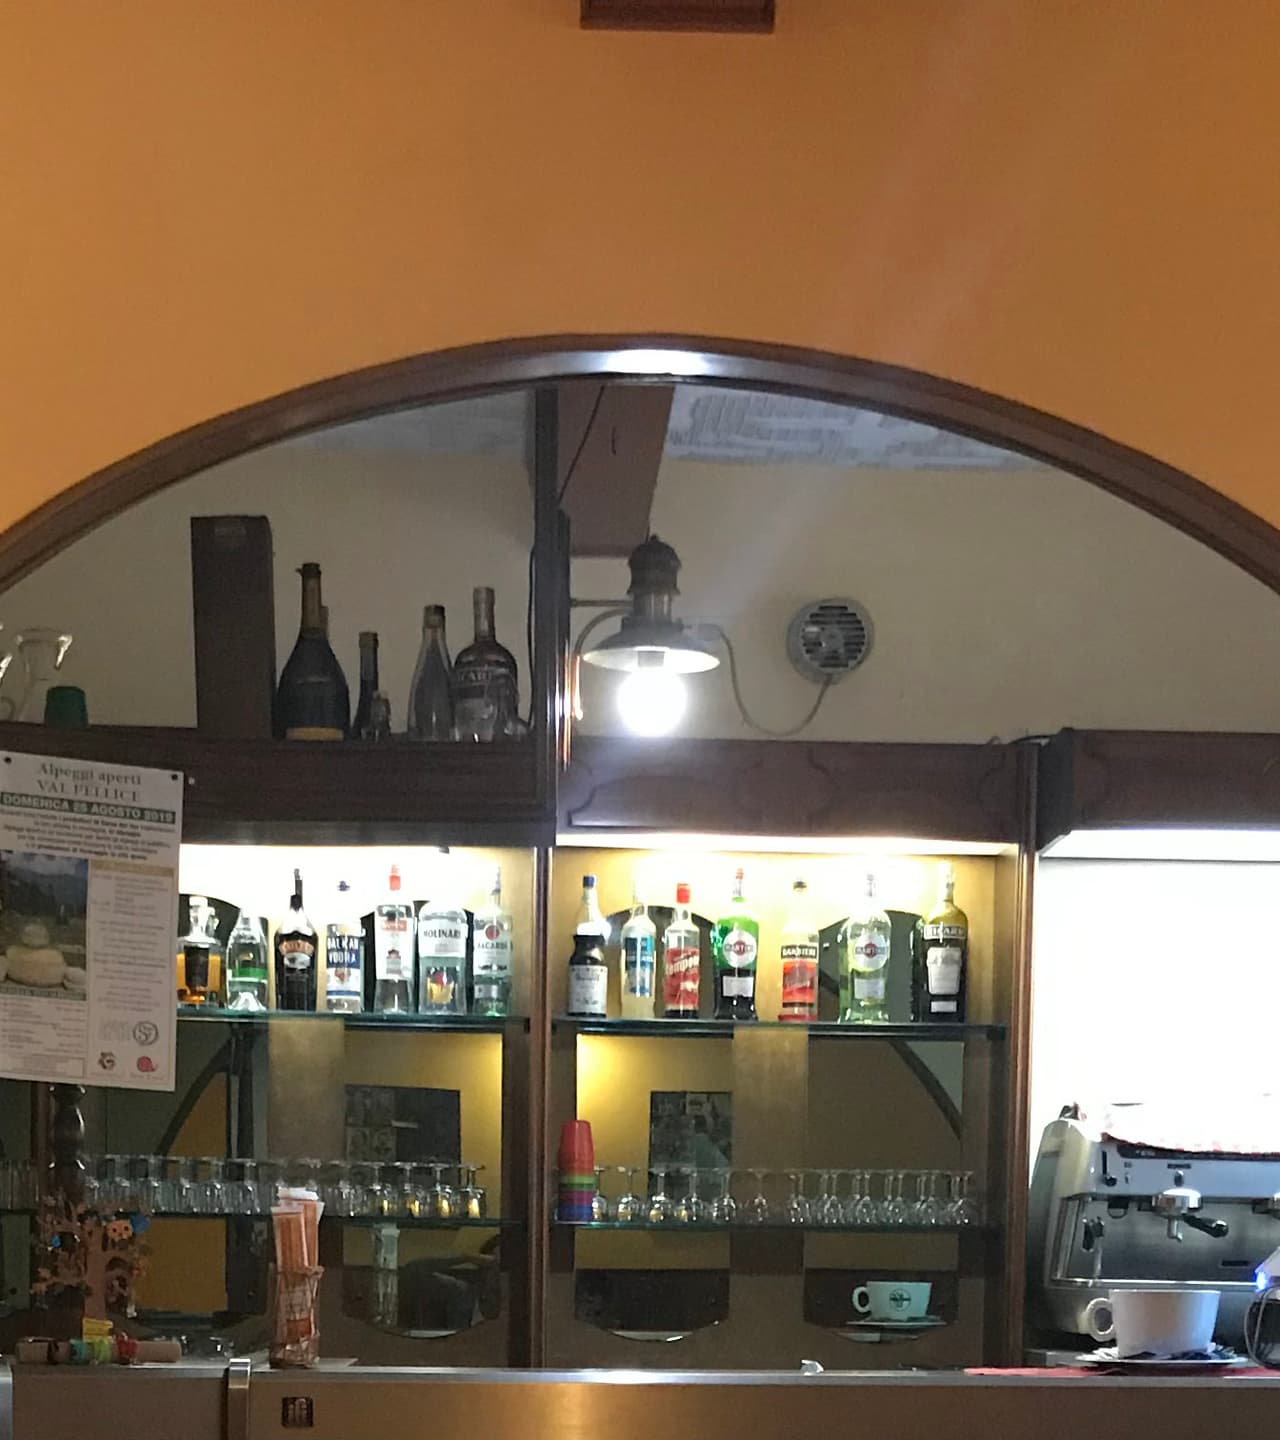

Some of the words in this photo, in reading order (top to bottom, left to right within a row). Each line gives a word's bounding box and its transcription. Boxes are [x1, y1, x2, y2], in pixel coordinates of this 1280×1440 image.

[39, 762, 94, 782] Alpeggi
[98, 772, 141, 786] aperti
[3, 794, 70, 812] DOMENICA
[91, 803, 141, 819] AGOSTO
